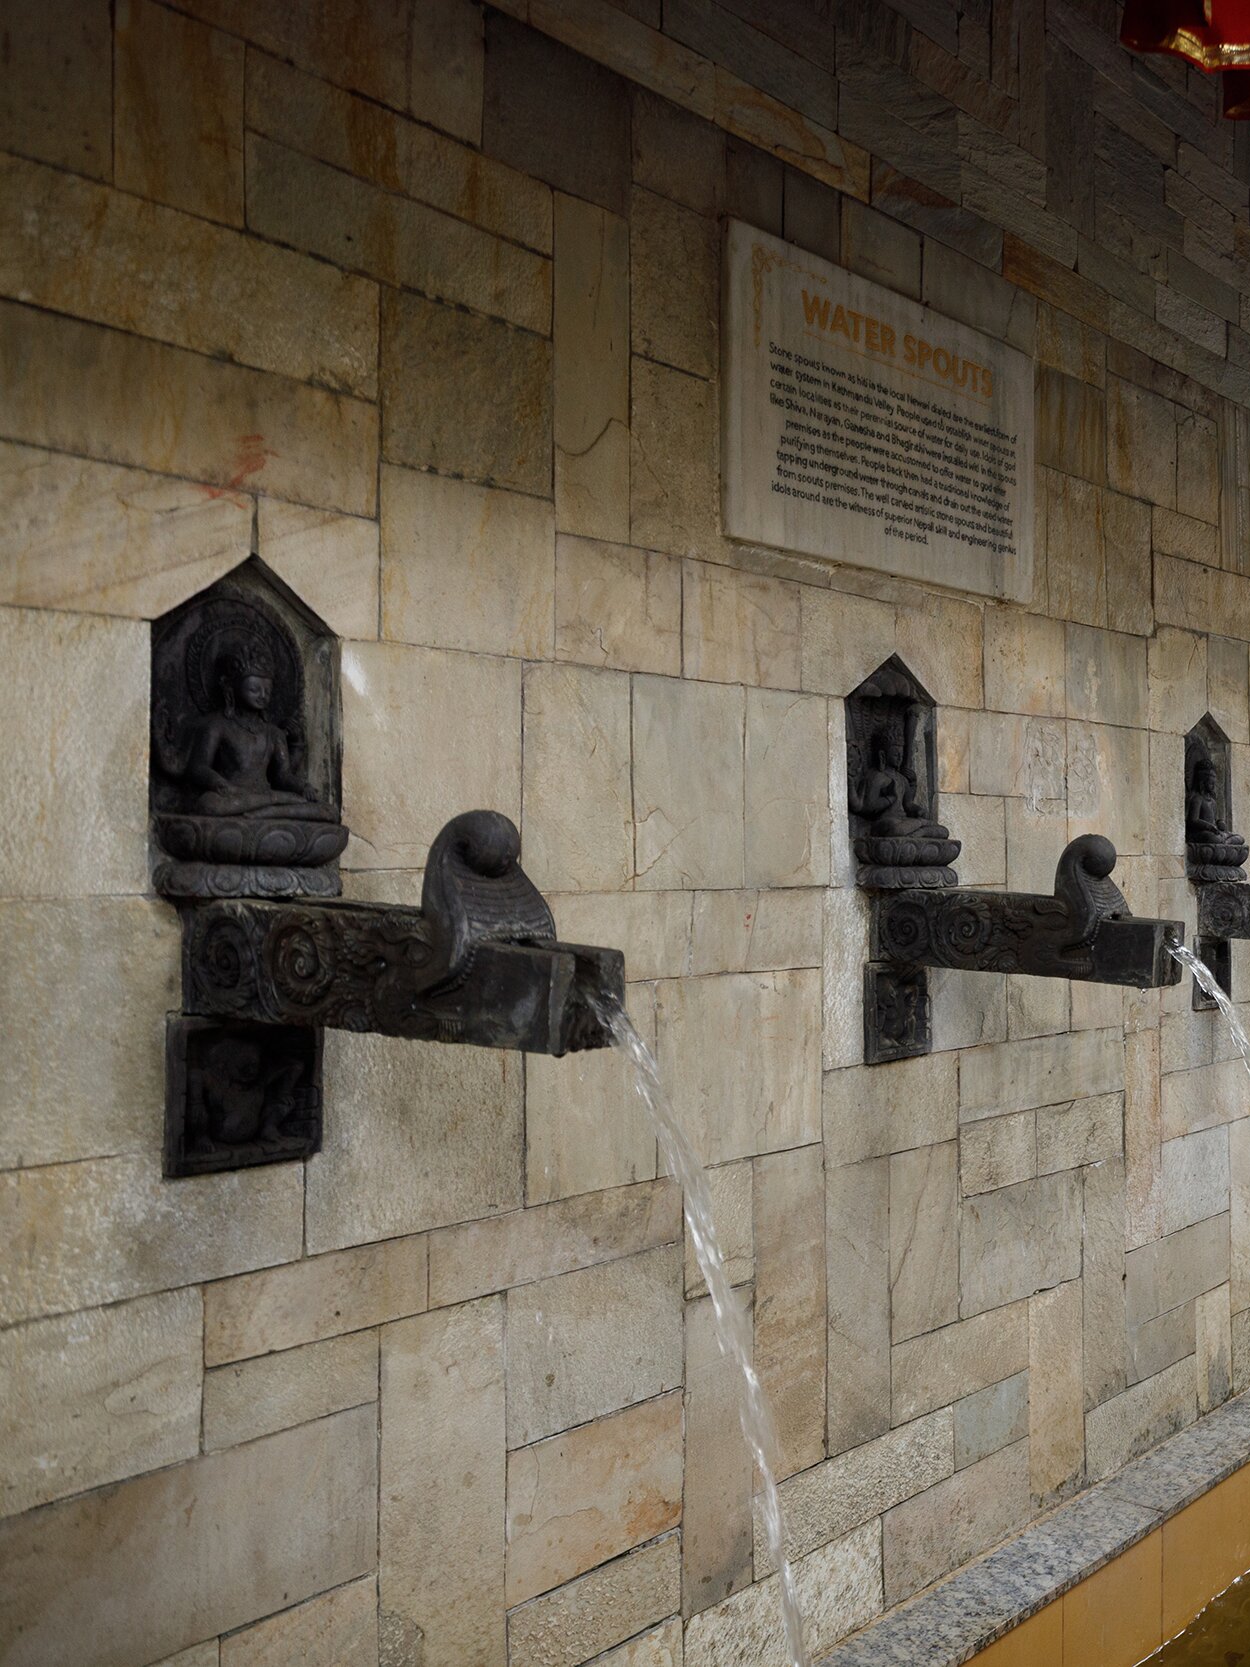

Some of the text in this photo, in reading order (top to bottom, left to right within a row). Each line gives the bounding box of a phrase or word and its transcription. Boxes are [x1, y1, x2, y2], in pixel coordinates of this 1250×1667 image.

[801, 289, 992, 398] WATER SPOUTS
[769, 341, 792, 360] Stone
[795, 354, 820, 370] spouts
[848, 373, 855, 383] as
[869, 379, 875, 391] in
[877, 382, 887, 395] the
[890, 387, 905, 402] local
[953, 413, 962, 423] are
[964, 415, 973, 428] the
[995, 428, 1009, 441] form
[1011, 435, 1017, 444] of
[770, 361, 792, 376] water
[795, 371, 821, 387] system
[823, 378, 829, 390] in
[832, 381, 872, 405] Kathmandu
[897, 405, 920, 422] People
[921, 416, 936, 428] used
[938, 420, 944, 431] to
[973, 436, 988, 447] water
[990, 442, 1008, 455] spouts
[770, 379, 796, 395] certain
[833, 401, 840, 410] as
[843, 402, 858, 416] their
[894, 422, 916, 436] source
[918, 430, 925, 439] of
[926, 433, 943, 445] water
[944, 438, 952, 448] for
[954, 441, 967, 457] daily
[998, 458, 1003, 467] of
[1004, 461, 1015, 471] god
[770, 393, 784, 407] like
[876, 431, 889, 442] and
[926, 448, 941, 459] were
[981, 465, 986, 475] in
[987, 467, 997, 479] the
[998, 473, 1016, 485] spouts
[781, 433, 815, 455] purifying
[817, 442, 859, 464] themselves.
[861, 455, 884, 474] People
[887, 463, 902, 478] back
[904, 469, 918, 482] then
[921, 474, 932, 487] had
[1004, 502, 1010, 511] of
[786, 418, 820, 436] premises
[822, 430, 830, 439] as
[832, 431, 844, 444] the
[845, 437, 871, 453] people
[873, 446, 889, 458] were
[891, 452, 930, 471] accustomed
[932, 464, 938, 474] to
[955, 473, 971, 484] water
[973, 477, 979, 487] to
[980, 481, 992, 491] god
[771, 479, 790, 495] idols
[792, 487, 820, 502] around
[822, 496, 833, 506] are
[835, 496, 847, 510] the
[848, 502, 875, 517] witness
[876, 509, 883, 519] of
[885, 513, 912, 527] superior
[935, 524, 947, 536] skill
[948, 529, 960, 539] and
[776, 463, 796, 479] from
[825, 480, 859, 497] premises.
[861, 487, 873, 501] The
[875, 494, 889, 505] well
[891, 498, 913, 512] carved
[936, 509, 953, 523] stone
[955, 516, 974, 529] spouts
[976, 522, 986, 532] and
[777, 445, 807, 468] tapping
[809, 458, 858, 480] underground
[859, 473, 878, 486] water
[880, 476, 907, 496] through
[930, 494, 941, 504] and
[943, 495, 959, 509] drain
[960, 503, 970, 513] out
[971, 504, 981, 516] the
[982, 510, 996, 520] used
[997, 514, 1012, 525] water
[885, 526, 928, 545] of the period.
